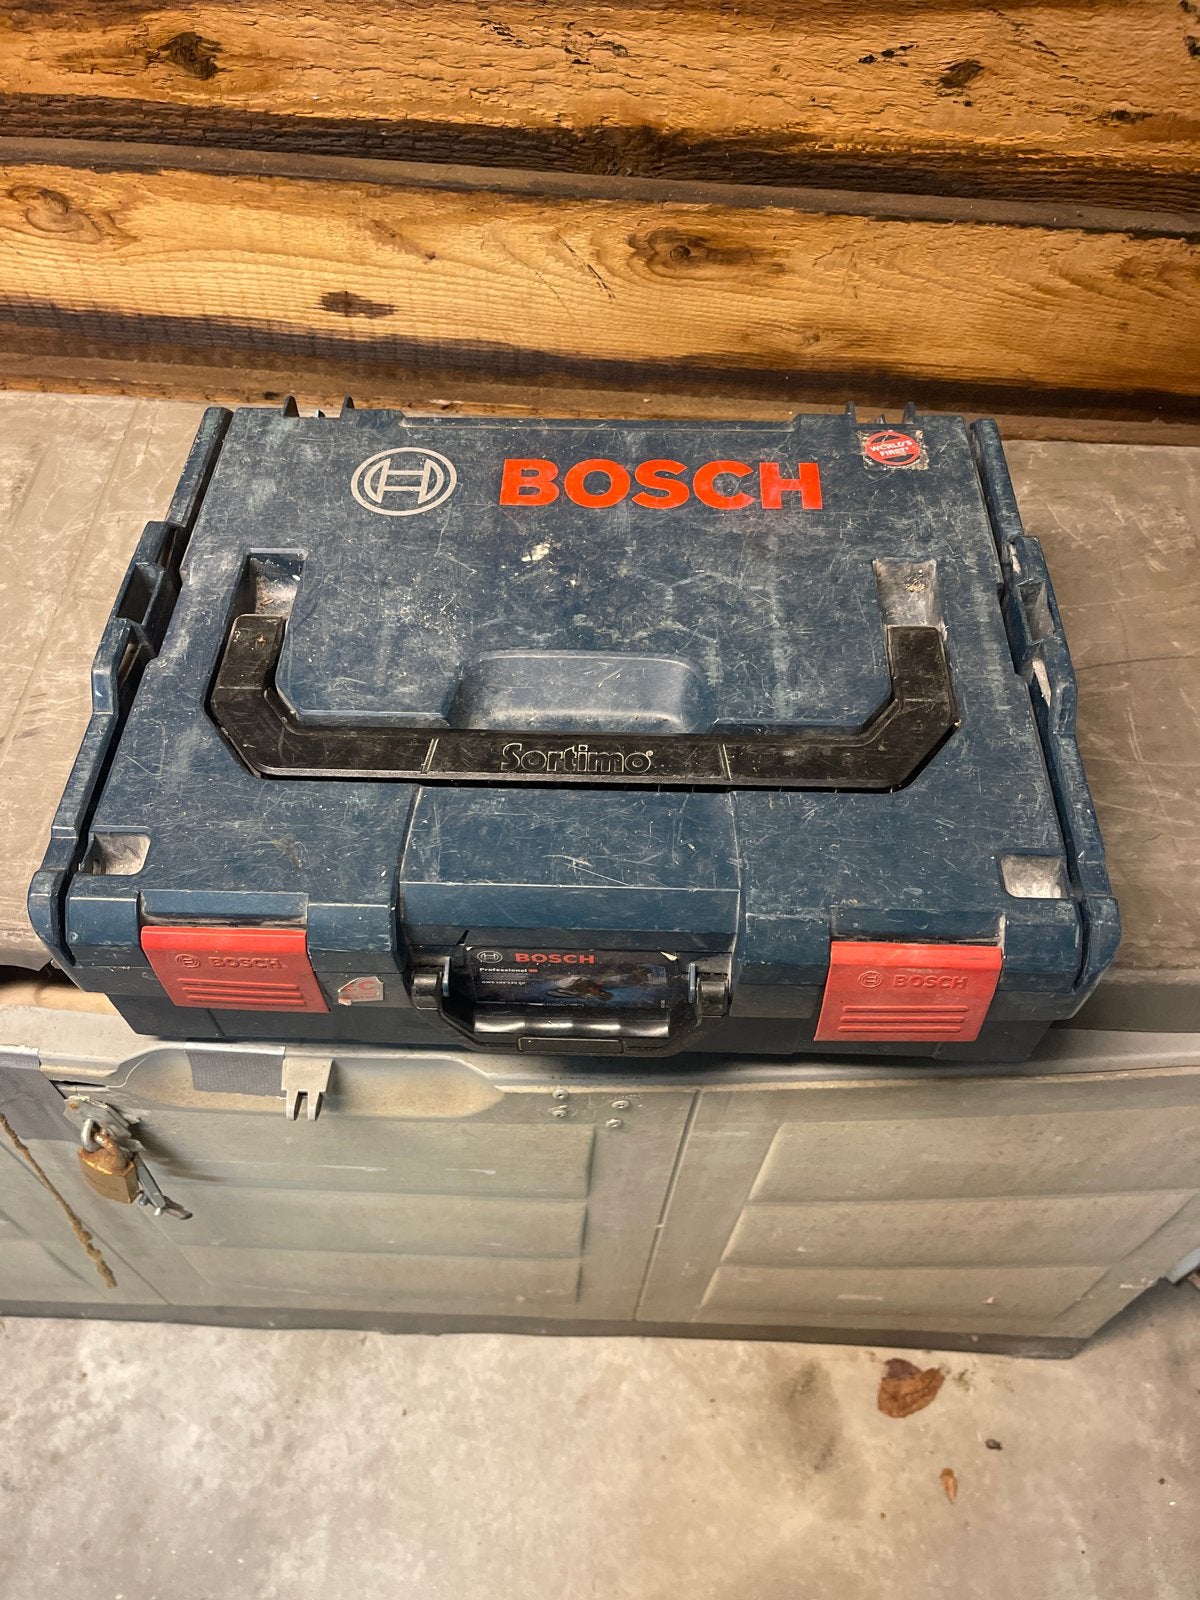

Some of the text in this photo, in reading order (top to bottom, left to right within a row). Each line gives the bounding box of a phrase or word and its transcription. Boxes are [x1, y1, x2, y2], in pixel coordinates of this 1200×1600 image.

[869, 439, 913, 452] WORLD'S
[498, 458, 823, 510] BOSCH
[208, 956, 284, 969] BOSCH
[514, 952, 596, 965] BOSCH
[892, 974, 968, 990] BOSCH
